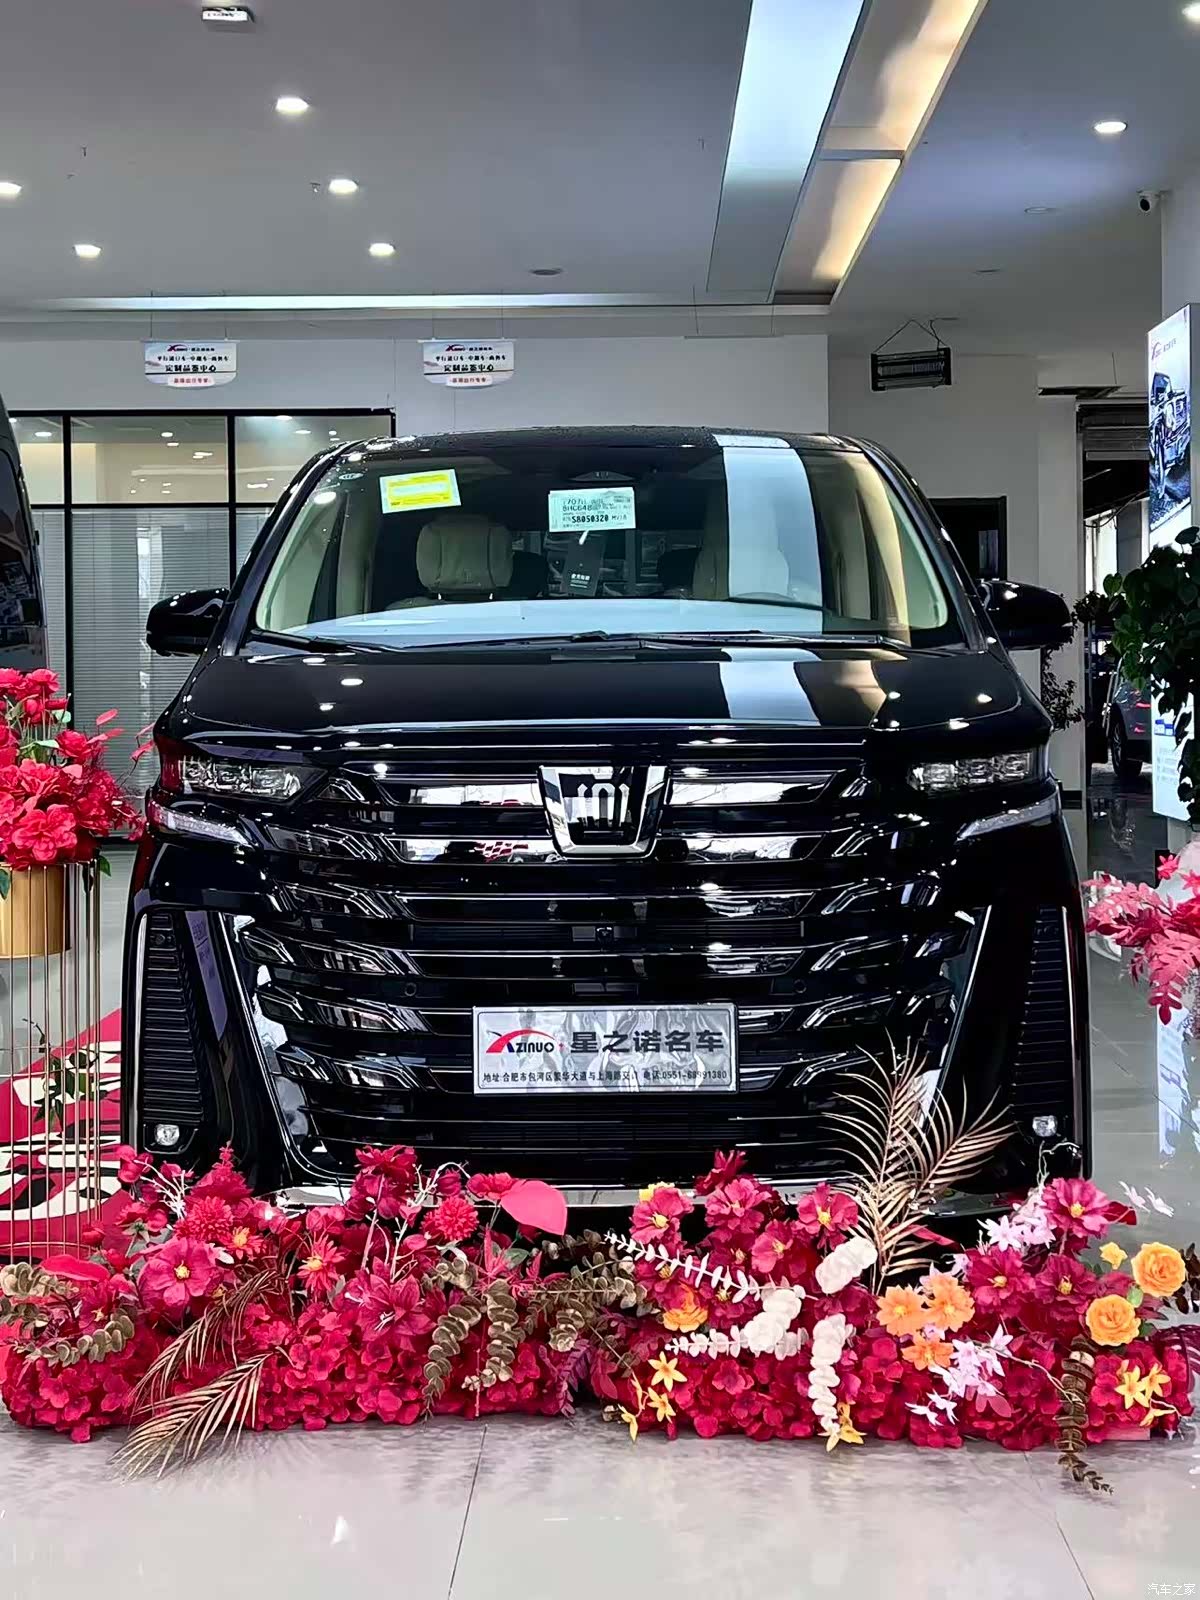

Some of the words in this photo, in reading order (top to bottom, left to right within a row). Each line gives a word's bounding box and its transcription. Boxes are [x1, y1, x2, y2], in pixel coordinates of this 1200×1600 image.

[570, 1029, 724, 1053] 星之诺名车
